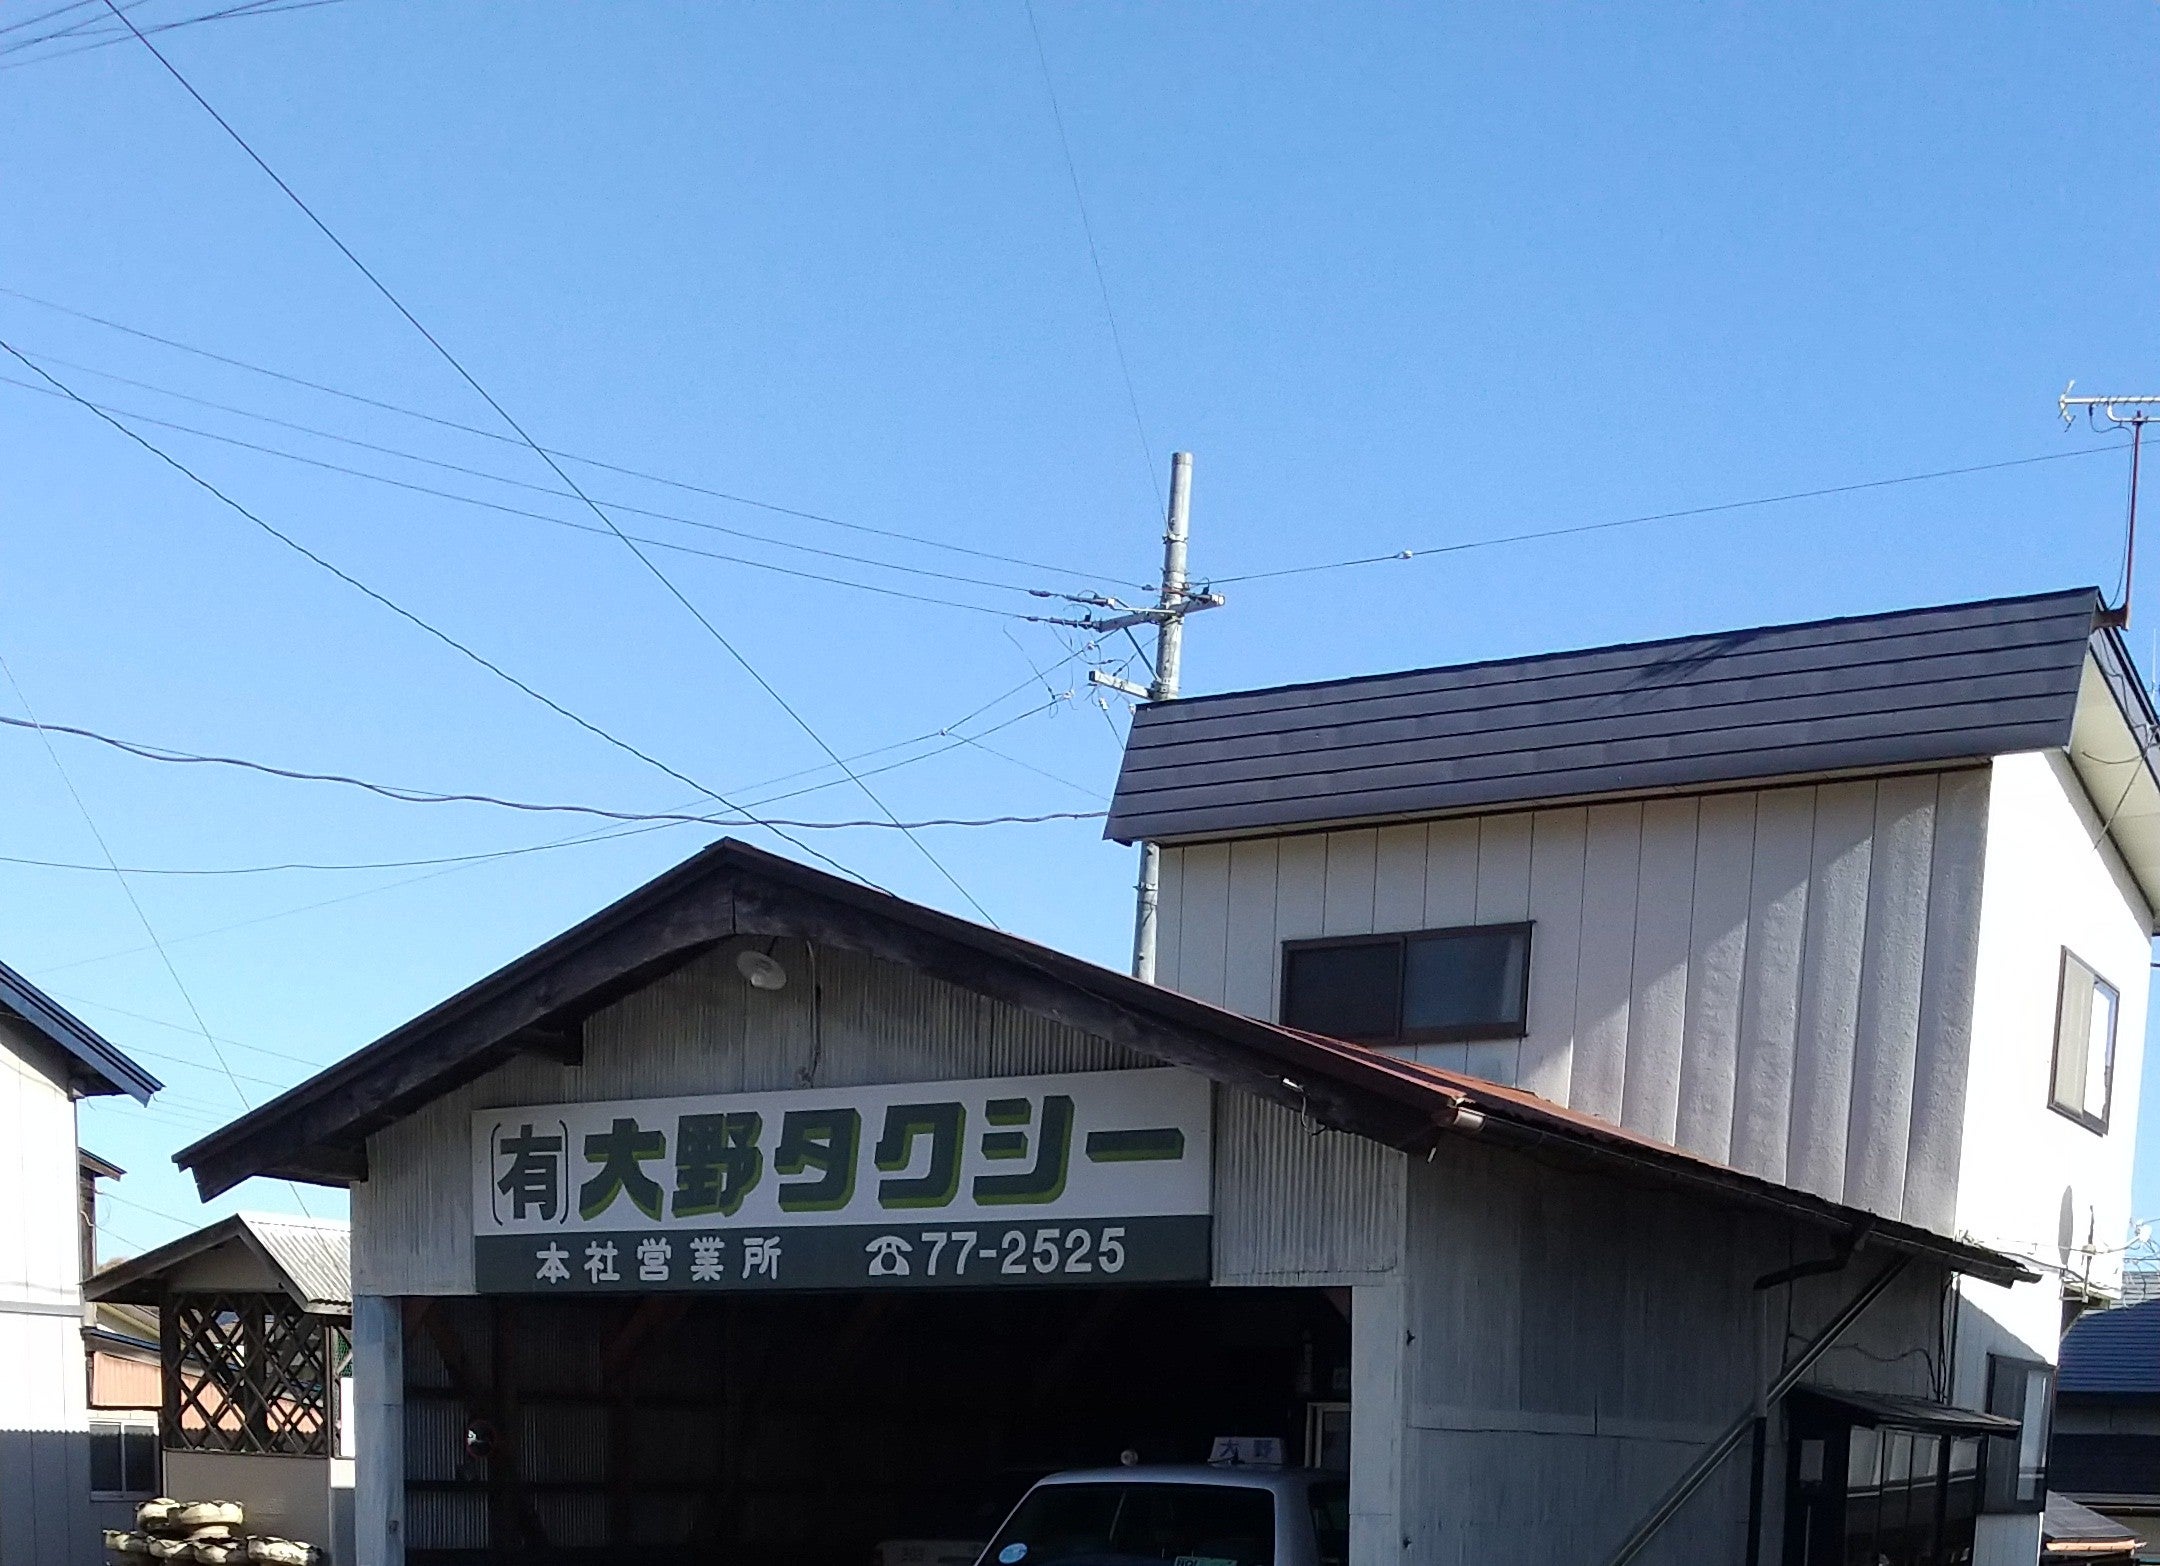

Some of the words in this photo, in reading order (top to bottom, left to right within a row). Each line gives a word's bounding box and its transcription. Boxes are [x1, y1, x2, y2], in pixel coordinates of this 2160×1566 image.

[536, 1236, 782, 1284] 本社営業所
[921, 1227, 1126, 1276] 77-2525
